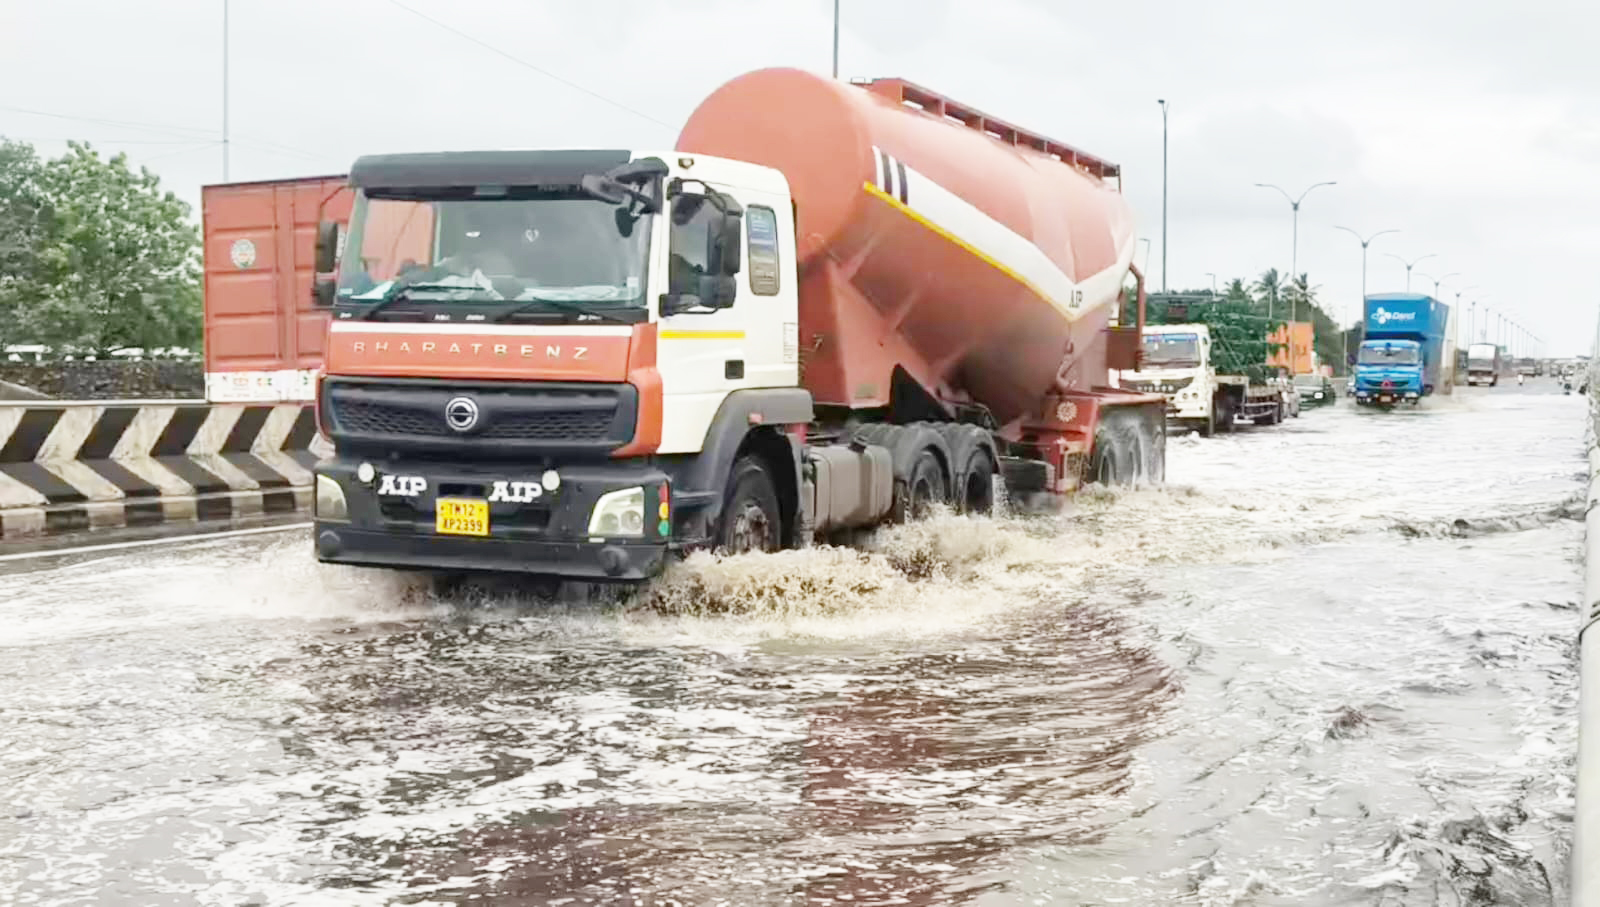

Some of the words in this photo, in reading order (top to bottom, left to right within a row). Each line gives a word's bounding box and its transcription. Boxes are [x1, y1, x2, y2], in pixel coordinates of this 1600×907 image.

[353, 342, 588, 360] BHARATBENZ
[378, 475, 427, 496] AIP
[488, 481, 542, 503] AIP
